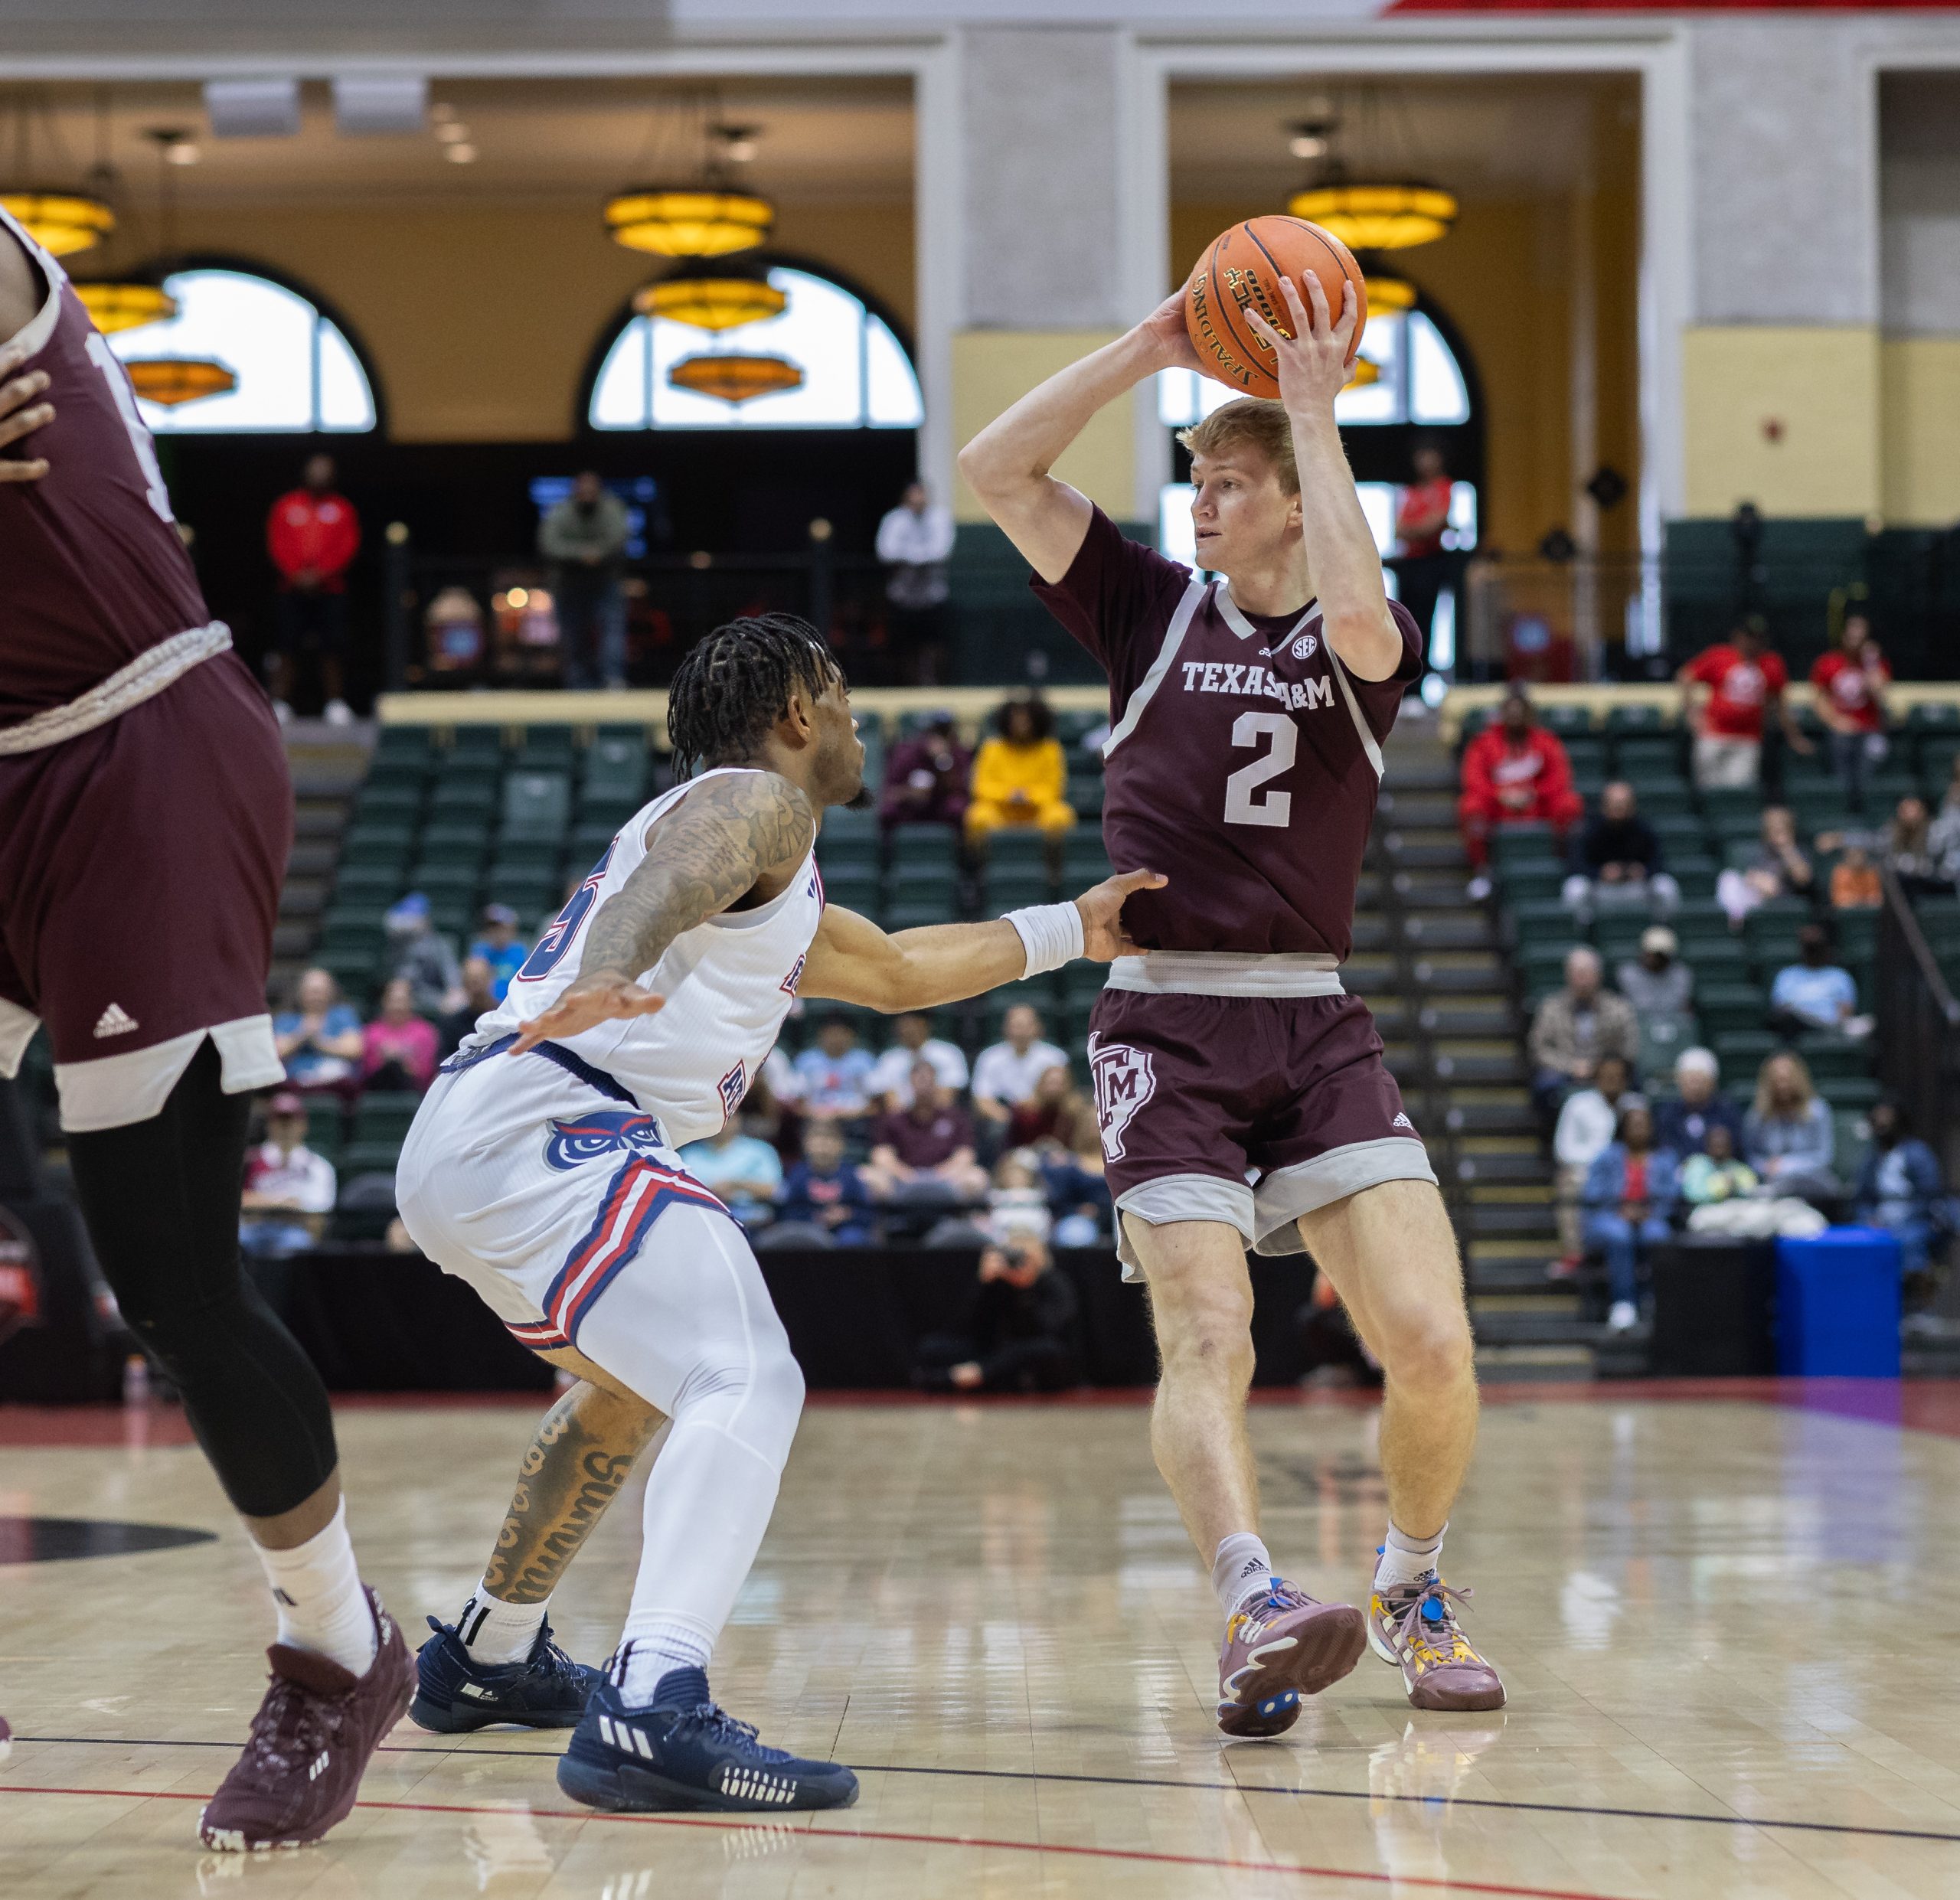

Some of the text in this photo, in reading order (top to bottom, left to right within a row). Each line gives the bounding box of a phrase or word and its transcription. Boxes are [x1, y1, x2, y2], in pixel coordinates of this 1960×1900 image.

[1192, 272, 1260, 386] SPALDING
[1223, 267, 1279, 365] LEACY
[1182, 661, 1279, 699] TEXAS
[1294, 637, 1316, 658] SEC
[1224, 711, 1298, 828] 2
